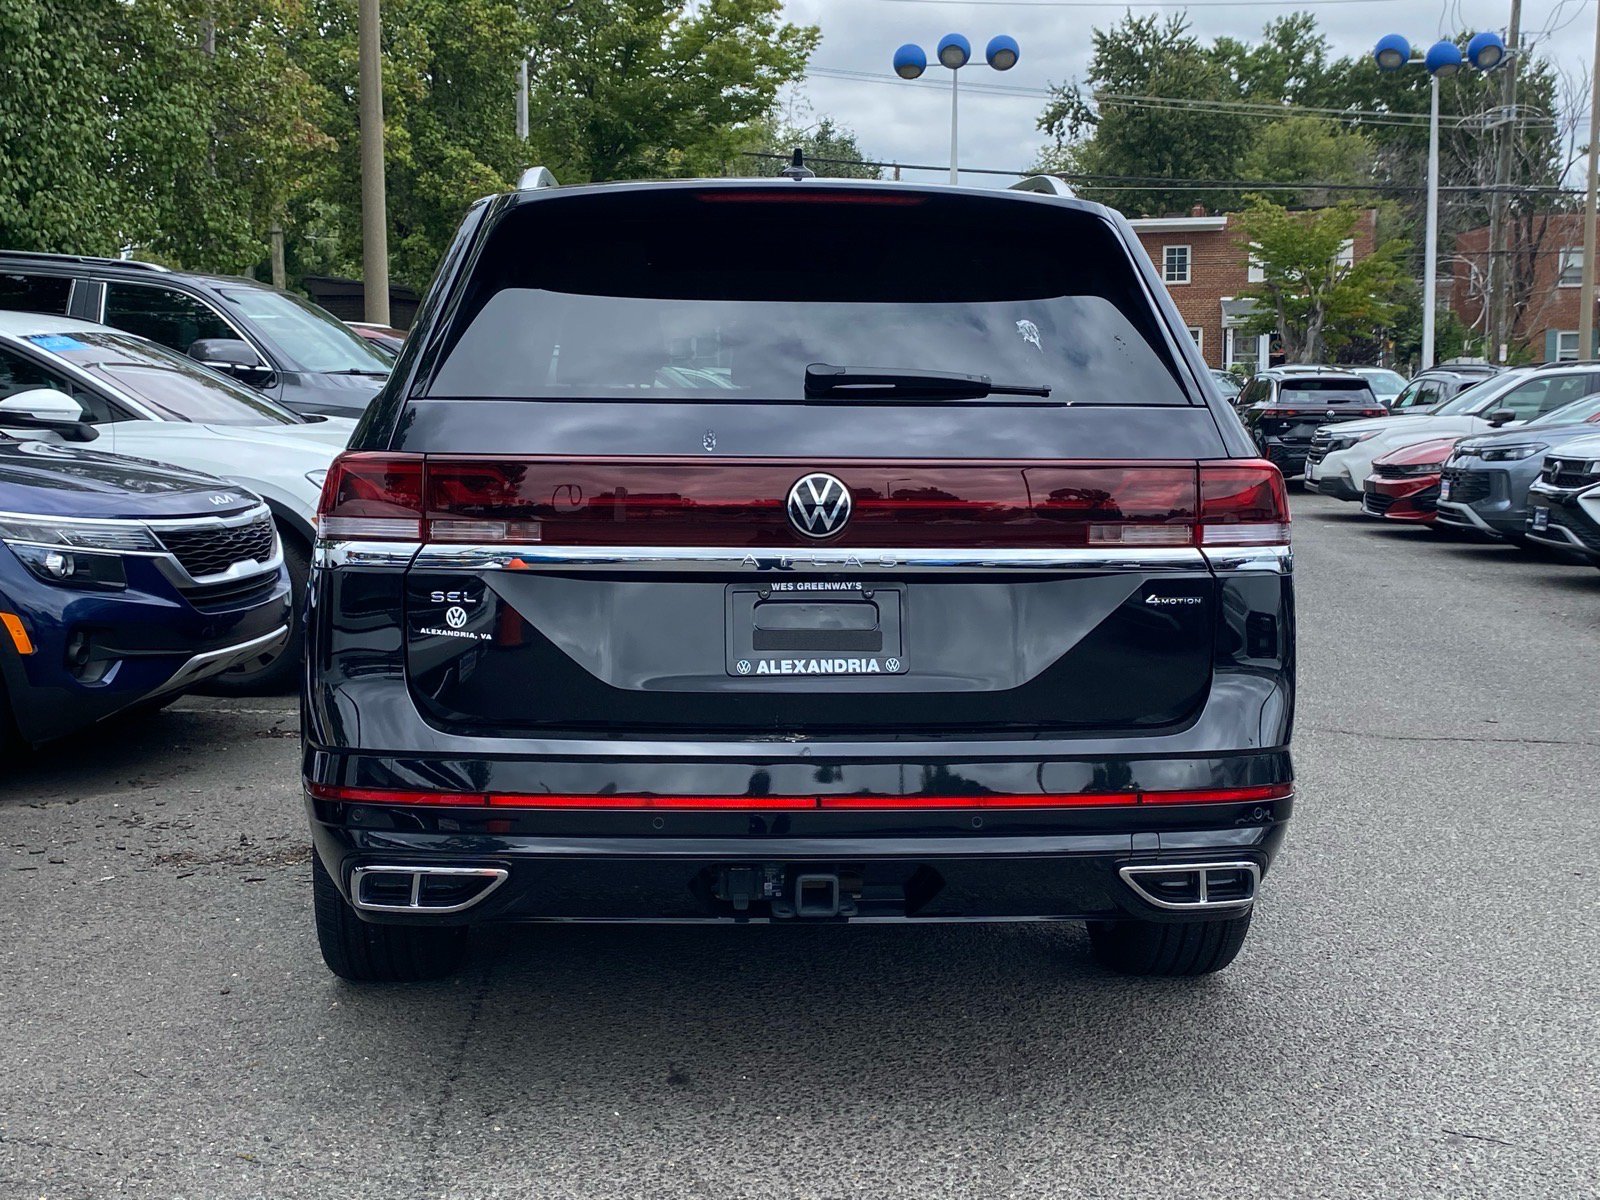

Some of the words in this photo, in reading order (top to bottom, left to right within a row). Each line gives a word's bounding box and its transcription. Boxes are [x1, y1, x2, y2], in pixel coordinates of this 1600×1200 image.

[788, 473, 851, 537] VW
[741, 553, 898, 569] ATLAS
[771, 582, 794, 591] WES
[796, 582, 863, 591] GREENWAY'S
[430, 591, 476, 603] SEL
[1145, 594, 1202, 606] 4MOTION
[446, 606, 467, 628] VW
[420, 627, 478, 640] ALEXANDRIA,
[756, 658, 881, 674] ALEXANDRIA
